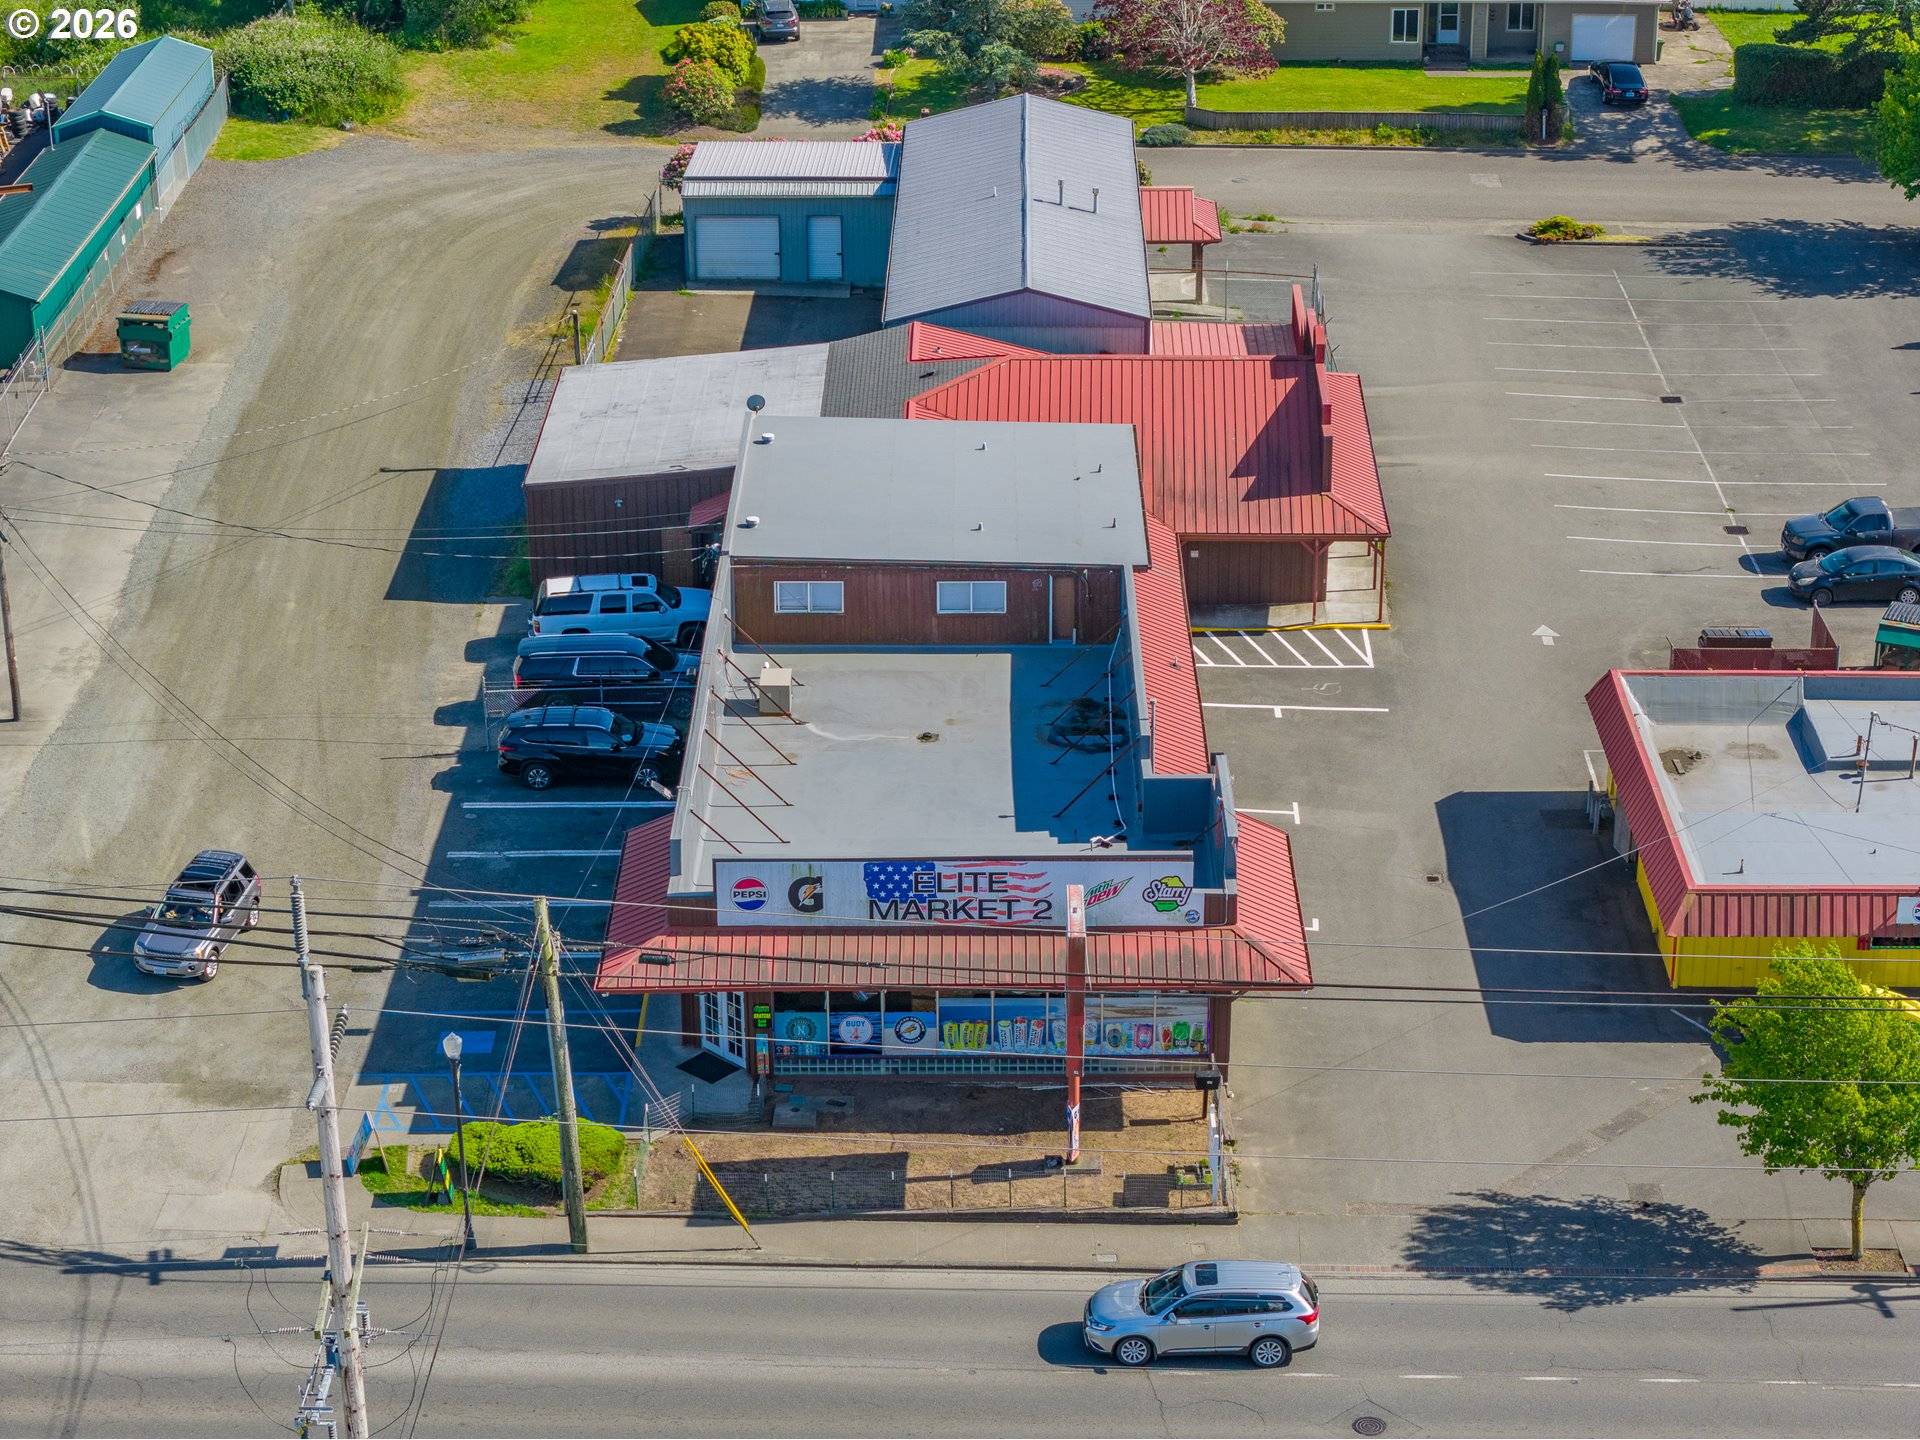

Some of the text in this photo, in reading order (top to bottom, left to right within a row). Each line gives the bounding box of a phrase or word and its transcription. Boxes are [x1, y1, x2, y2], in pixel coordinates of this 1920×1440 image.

[912, 871, 1009, 893] ELITE
[1142, 879, 1193, 907] Starry
[733, 890, 767, 899] PEPSI
[787, 876, 824, 913] G
[869, 898, 1053, 920] MARKET 2
